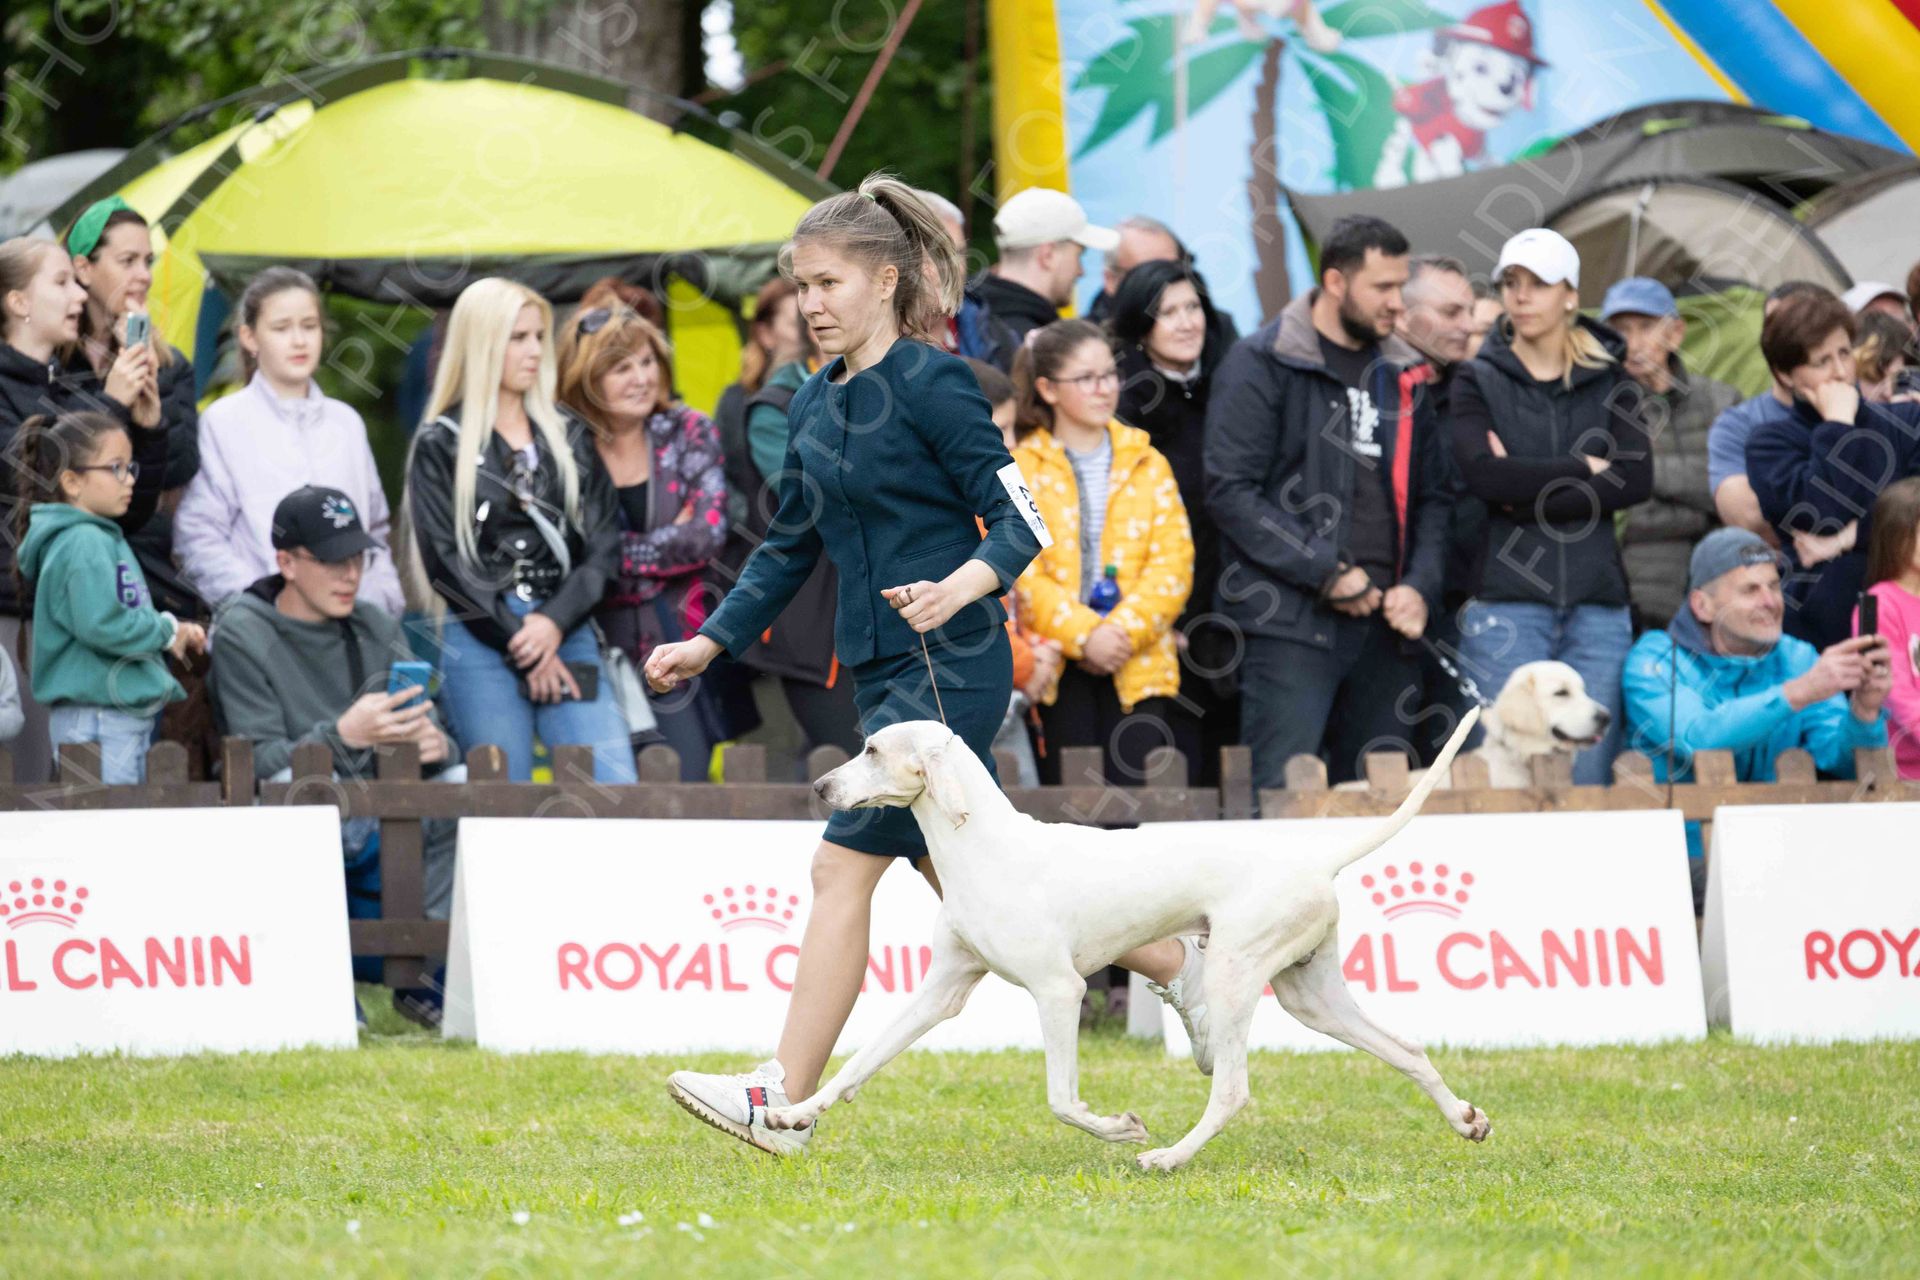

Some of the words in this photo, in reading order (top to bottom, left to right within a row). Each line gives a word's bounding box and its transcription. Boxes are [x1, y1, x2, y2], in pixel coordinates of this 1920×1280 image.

[53, 934, 252, 990] CANIN
[557, 942, 749, 992] ROYAL
[1435, 926, 1665, 991] CANIN
[1804, 927, 1920, 980] ROY
